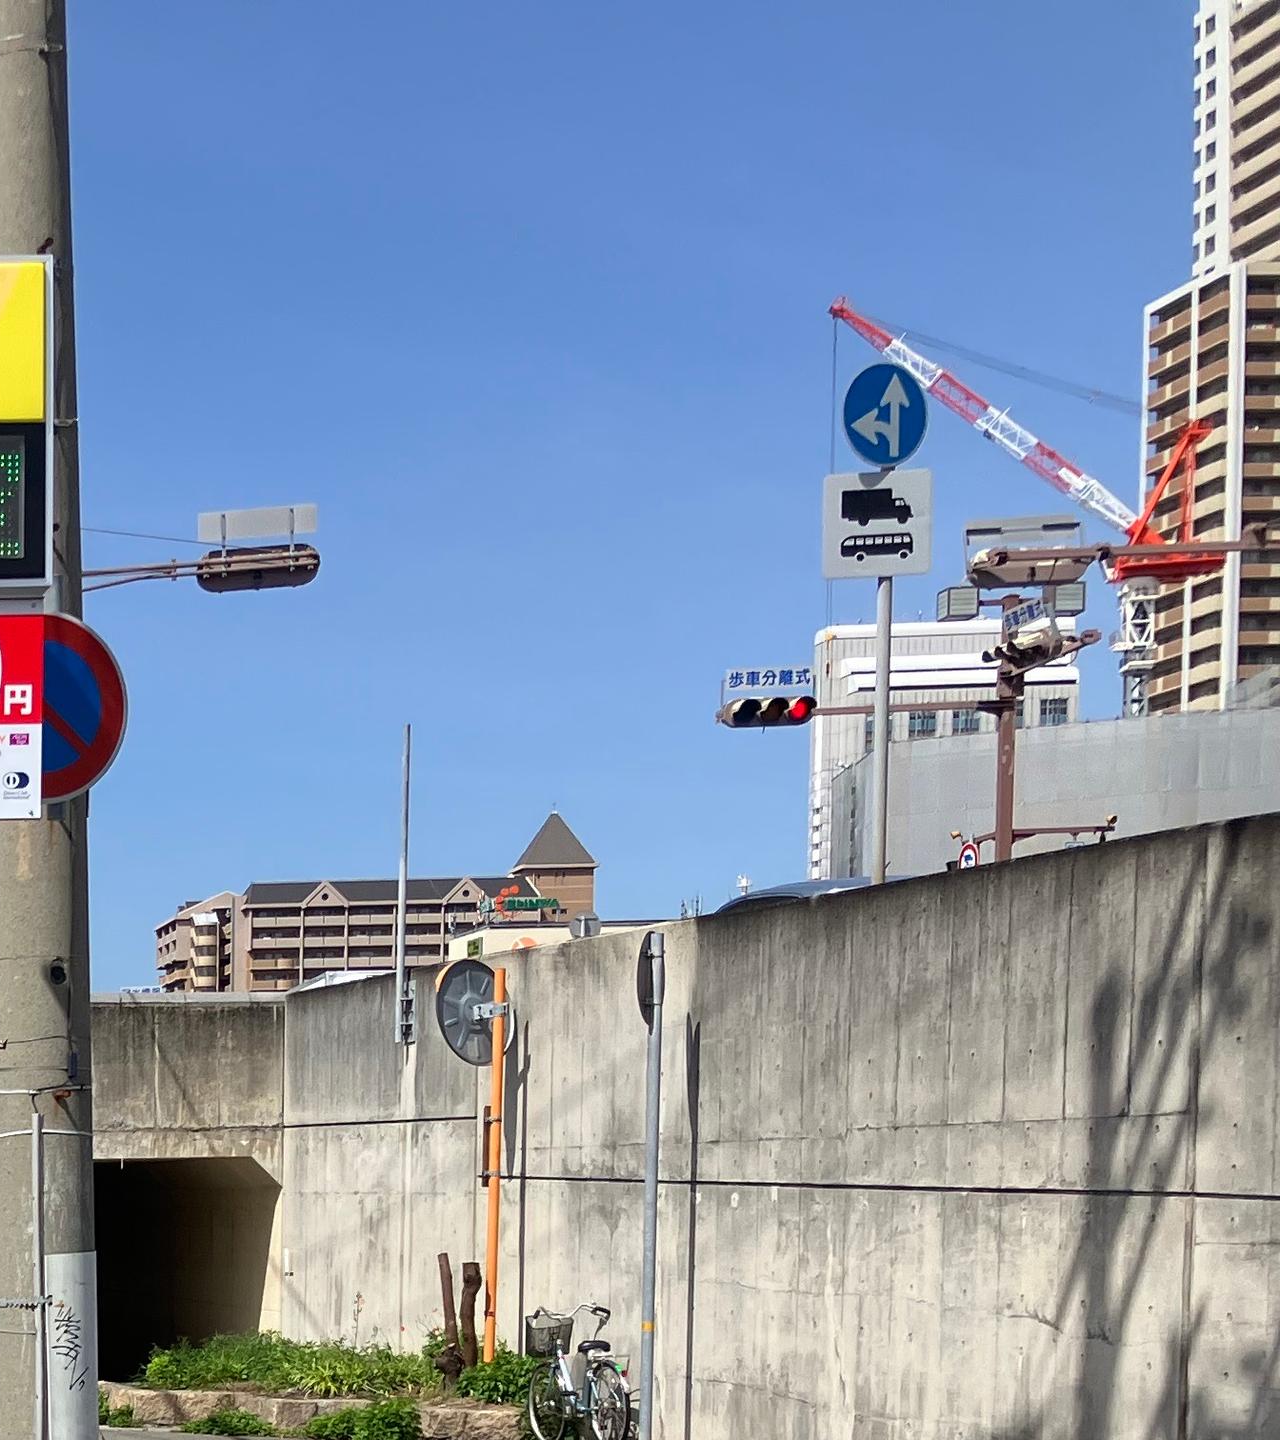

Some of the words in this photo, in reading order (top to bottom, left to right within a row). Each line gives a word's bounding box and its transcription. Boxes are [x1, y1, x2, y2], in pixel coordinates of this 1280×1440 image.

[728, 668, 811, 689] 歩車分離式
